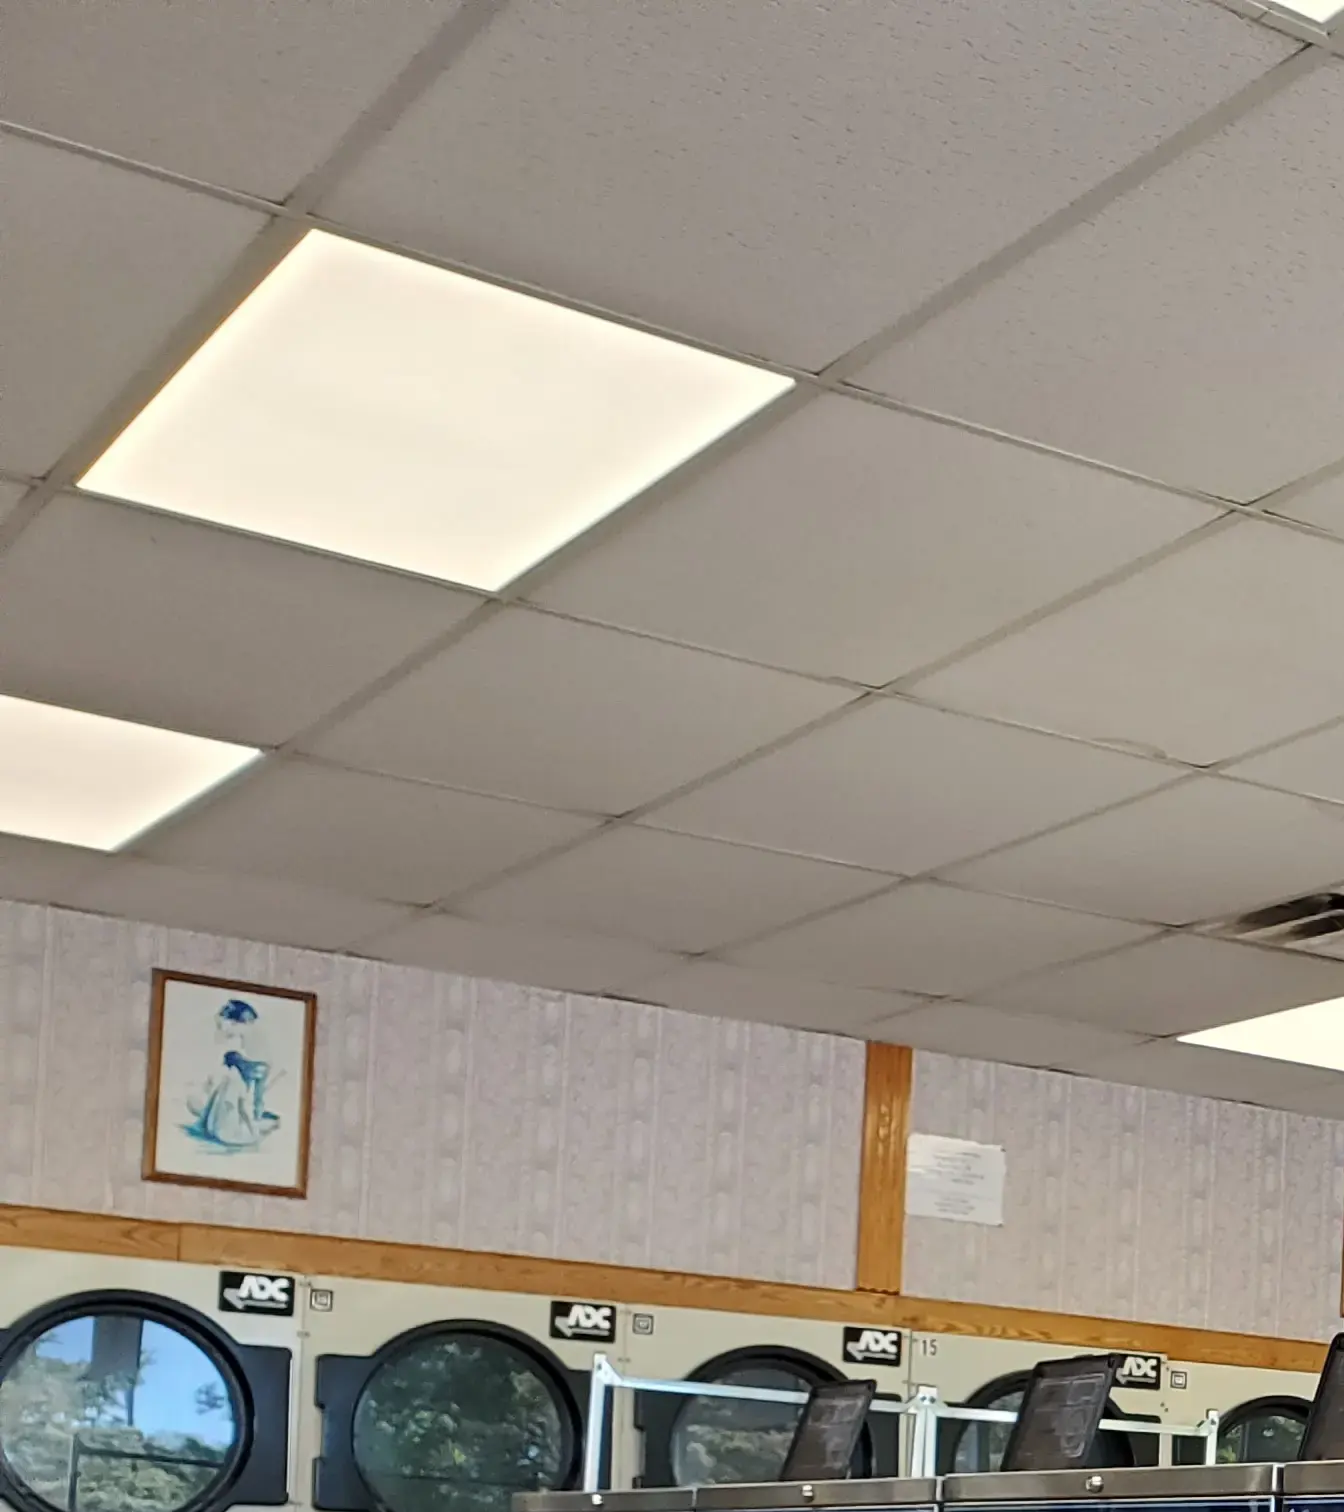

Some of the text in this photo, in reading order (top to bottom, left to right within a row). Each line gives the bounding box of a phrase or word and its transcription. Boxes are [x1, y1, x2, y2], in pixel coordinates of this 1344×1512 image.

[237, 1275, 289, 1301] ADC
[567, 1303, 611, 1330] ADC
[859, 1330, 897, 1353] ADC
[921, 1339, 938, 1356] 15
[1121, 1357, 1157, 1379] ADC
